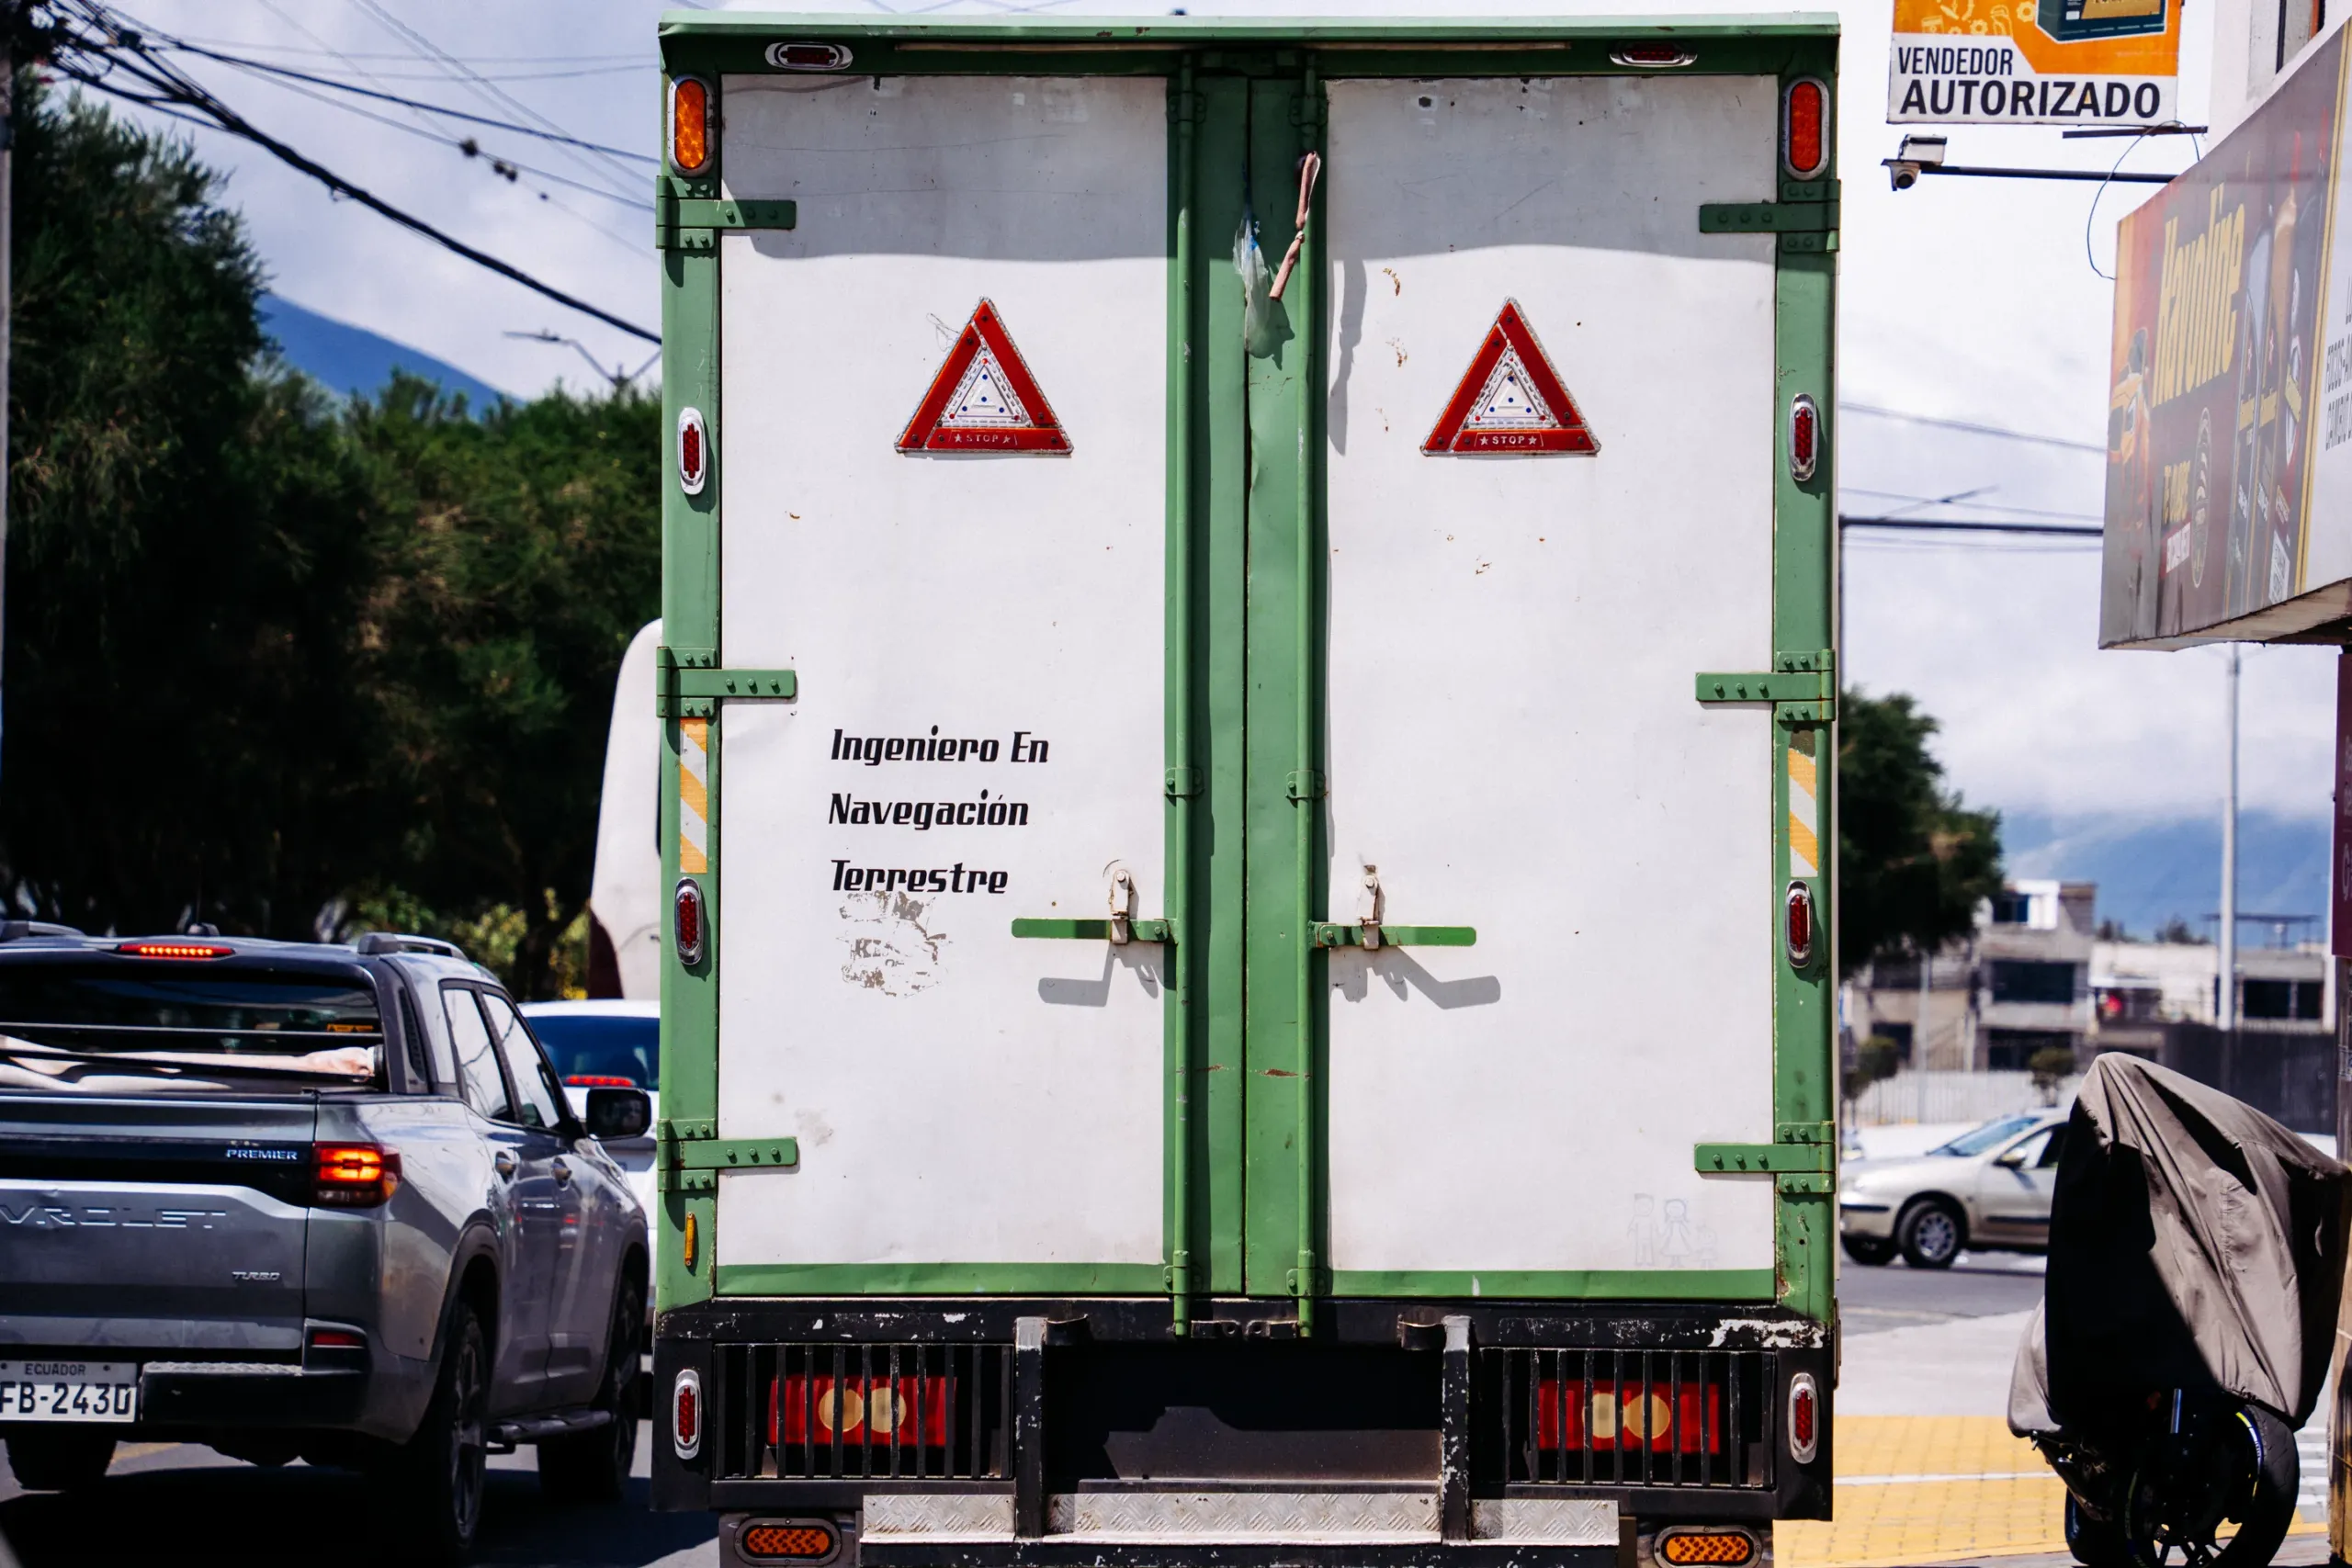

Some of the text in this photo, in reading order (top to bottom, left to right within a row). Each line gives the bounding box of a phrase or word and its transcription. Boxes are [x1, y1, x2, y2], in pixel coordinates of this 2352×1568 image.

[1898, 47, 2013, 75] VENDEDOR
[1899, 79, 2160, 118] AUTORIZADO
[2152, 182, 2245, 409] Havoline
[966, 434, 999, 443] STOP
[1492, 435, 1525, 445] STOP
[831, 724, 1049, 766] Ingeniero En
[829, 788, 1029, 831] Navegación
[831, 859, 1009, 895] Terrestre
[225, 1148, 298, 1160] PREMIER
[232, 1271, 281, 1281] TURBO
[24, 1362, 86, 1376] ECUADOR
